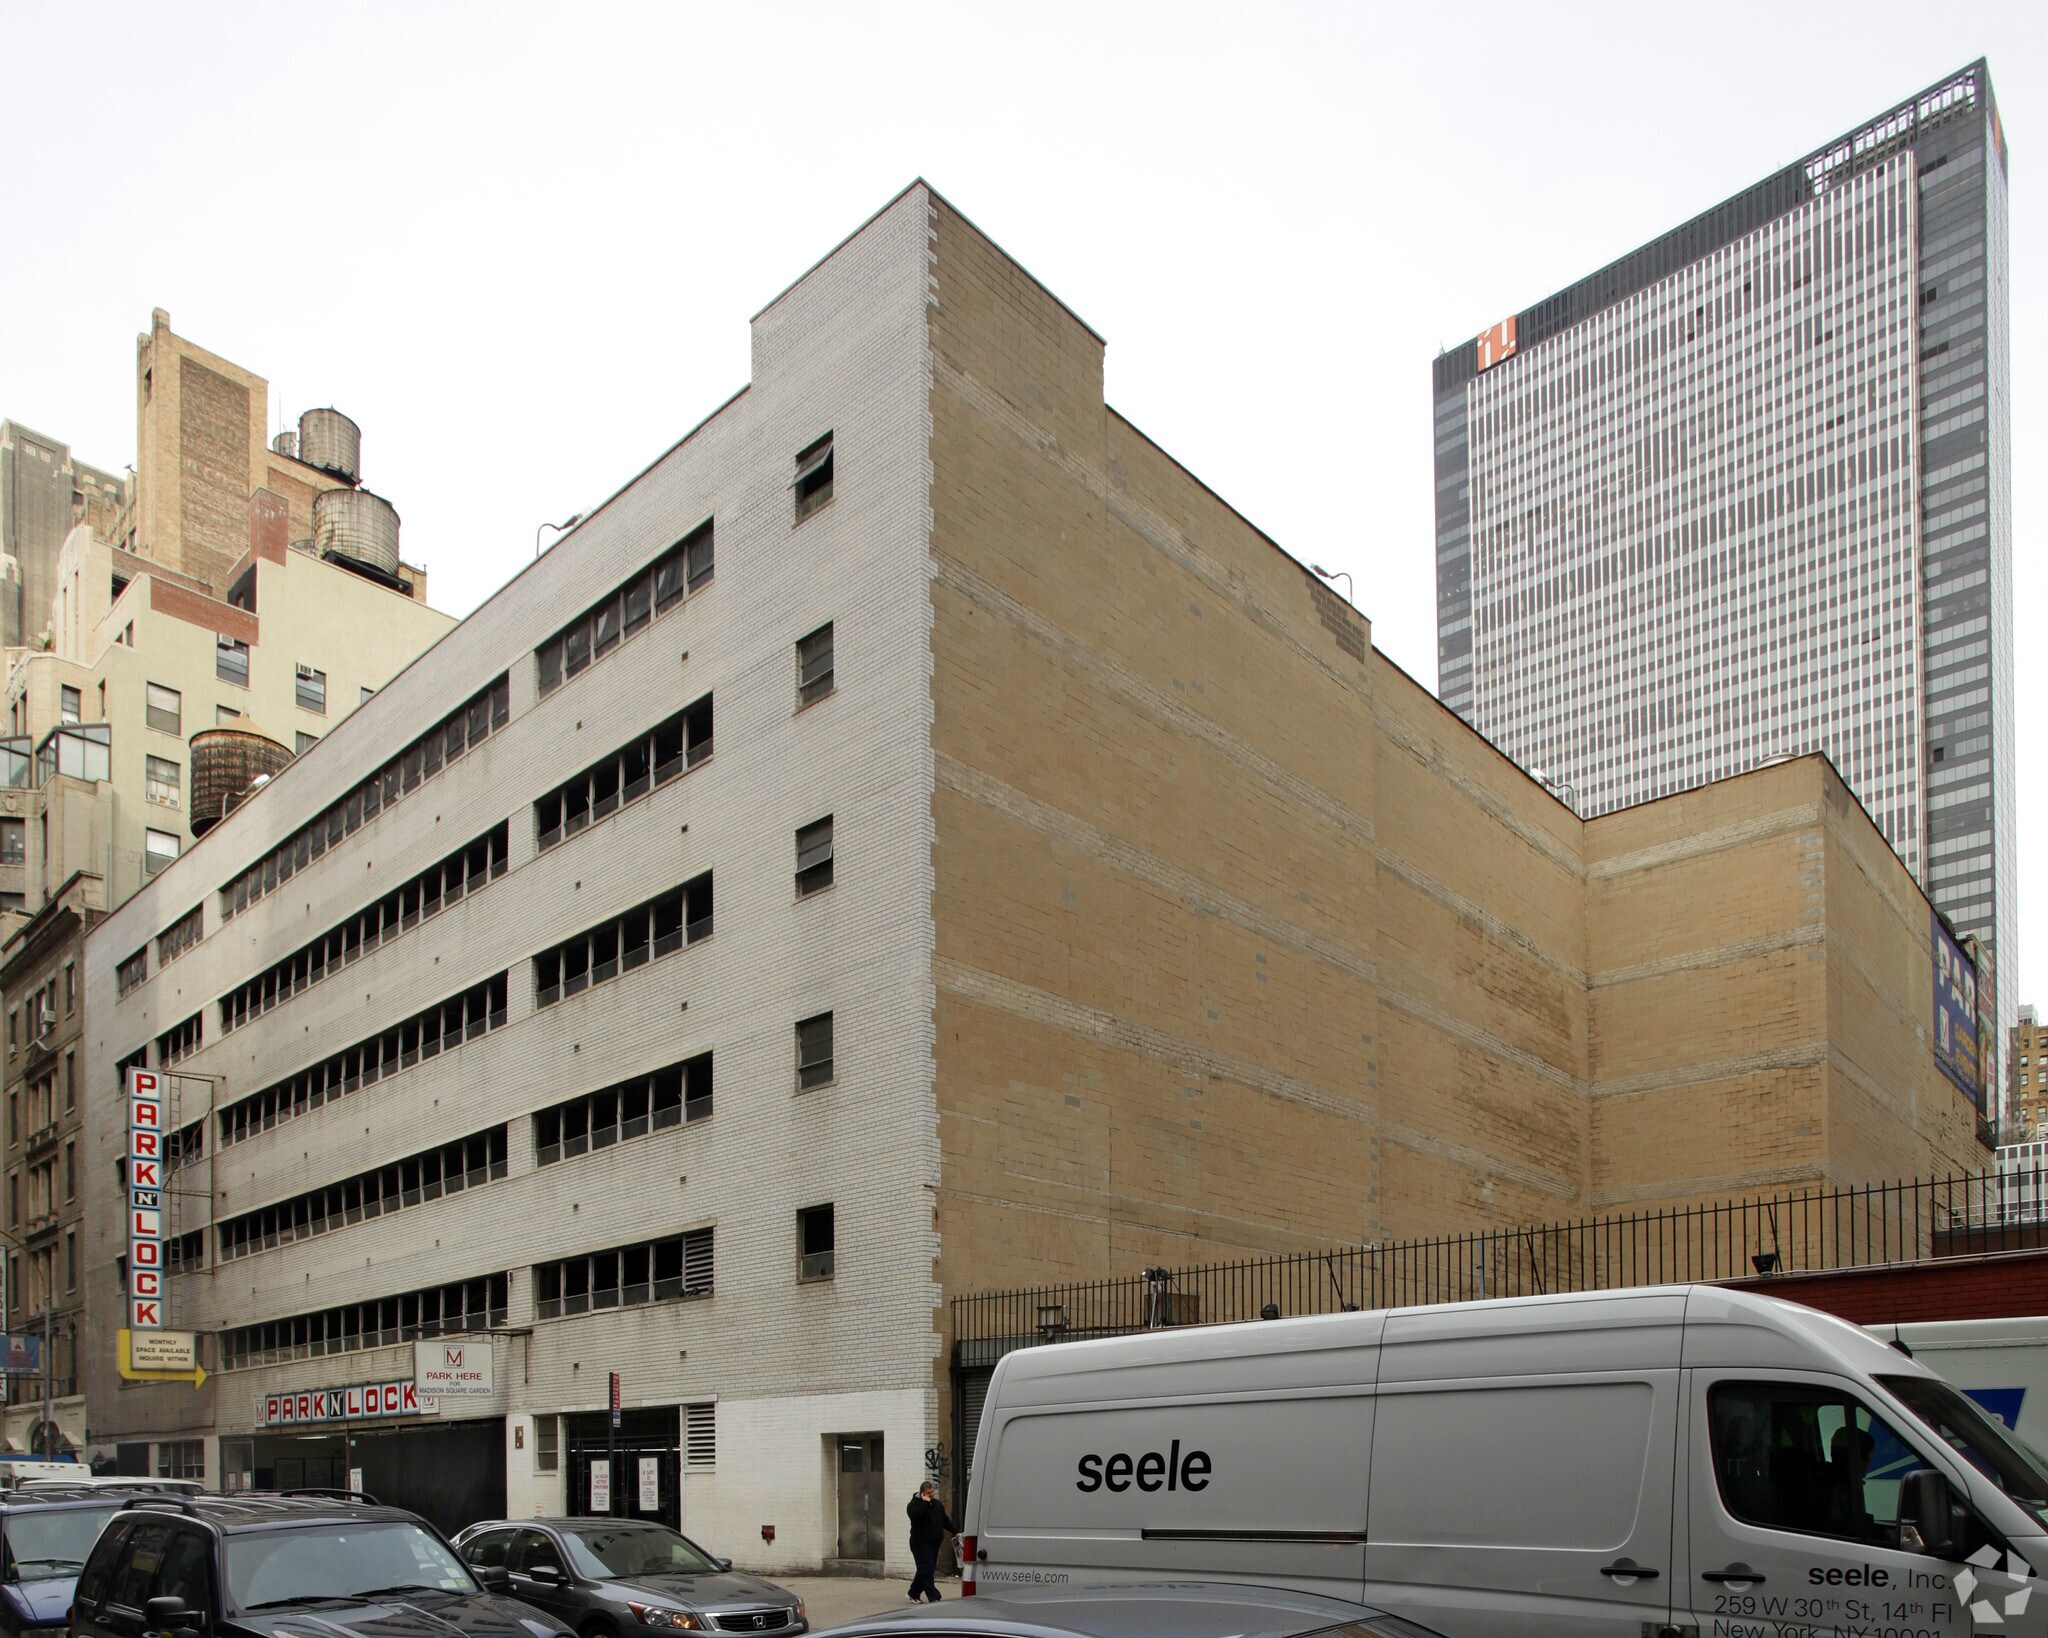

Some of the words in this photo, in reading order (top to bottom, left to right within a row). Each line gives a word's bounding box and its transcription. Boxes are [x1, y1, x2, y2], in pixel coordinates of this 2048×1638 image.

[135, 1072, 158, 1186] PARK
[135, 1212, 159, 1325] LOCK
[426, 1371, 453, 1380] PARK
[456, 1372, 483, 1380] HERE
[268, 1393, 325, 1421] PARK
[347, 1384, 418, 1414] LOCK
[1076, 1439, 1212, 1493] seele
[981, 1569, 1069, 1584] www.seele.com
[1908, 1568, 1952, 1590] Inc.
[1714, 1595, 1756, 1615] 259
[1761, 1596, 1789, 1616] W
[1845, 1600, 1875, 1624] St,
[1713, 1618, 1765, 1638] New
[1834, 1624, 1869, 1638] NY
